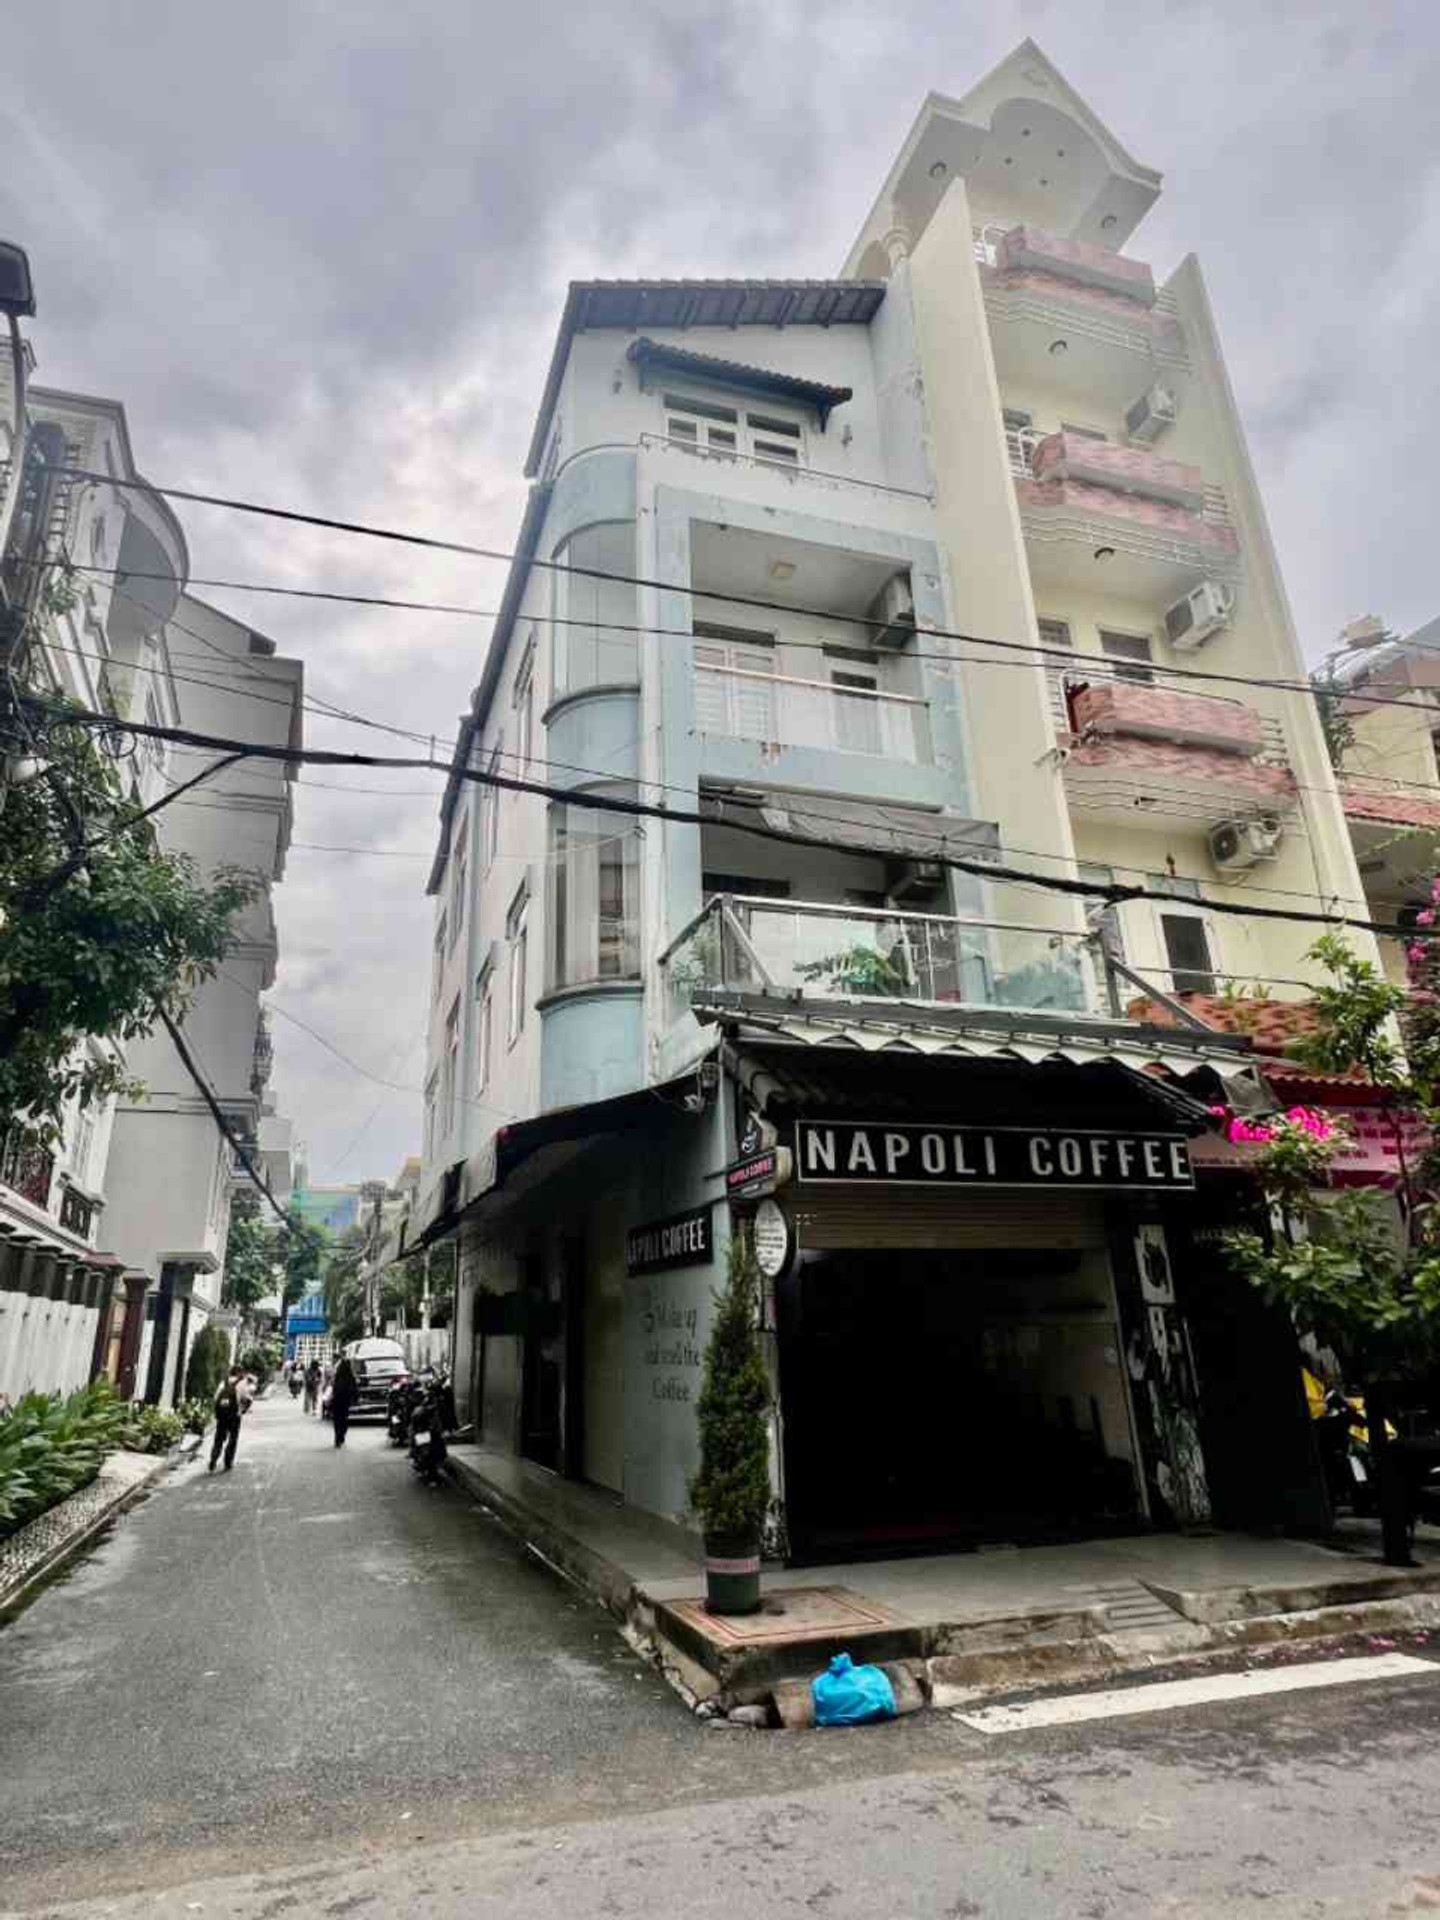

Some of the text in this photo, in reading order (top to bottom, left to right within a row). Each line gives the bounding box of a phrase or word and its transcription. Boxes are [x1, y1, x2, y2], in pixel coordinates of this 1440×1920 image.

[806, 1128, 1190, 1180] NAPOLI COFFEE
[661, 1217, 706, 1258] COFFEE
